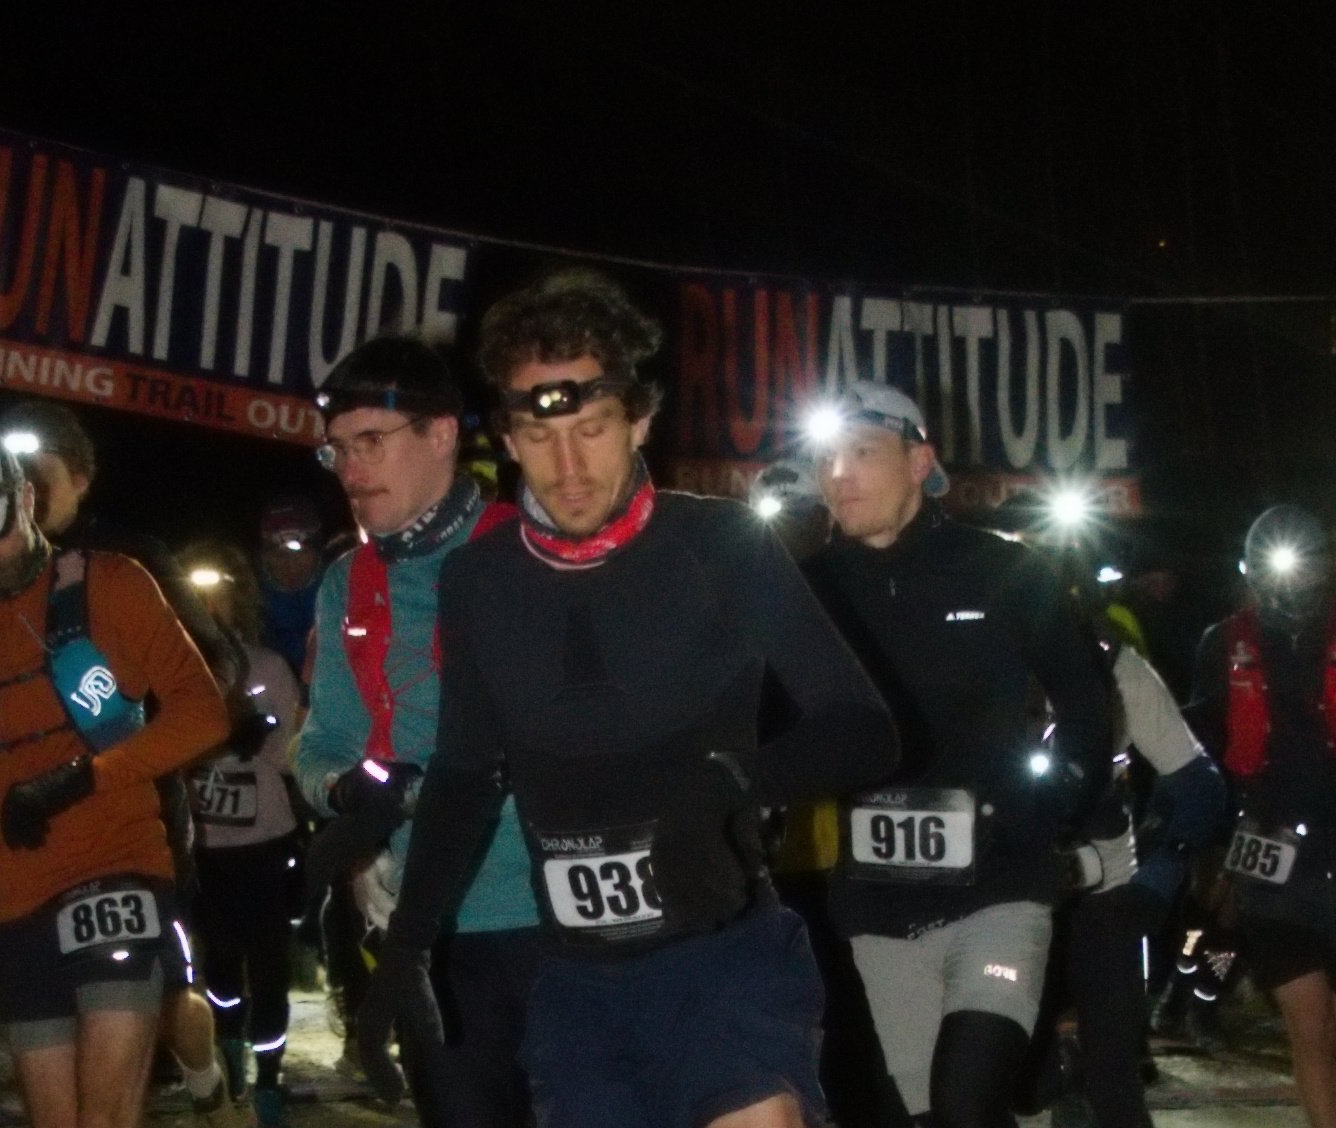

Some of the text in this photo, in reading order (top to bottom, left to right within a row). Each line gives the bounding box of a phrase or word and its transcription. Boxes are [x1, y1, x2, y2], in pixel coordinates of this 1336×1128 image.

[125, 373, 236, 423] TRAIL
[870, 814, 946, 863] 916
[72, 893, 147, 944] 863
